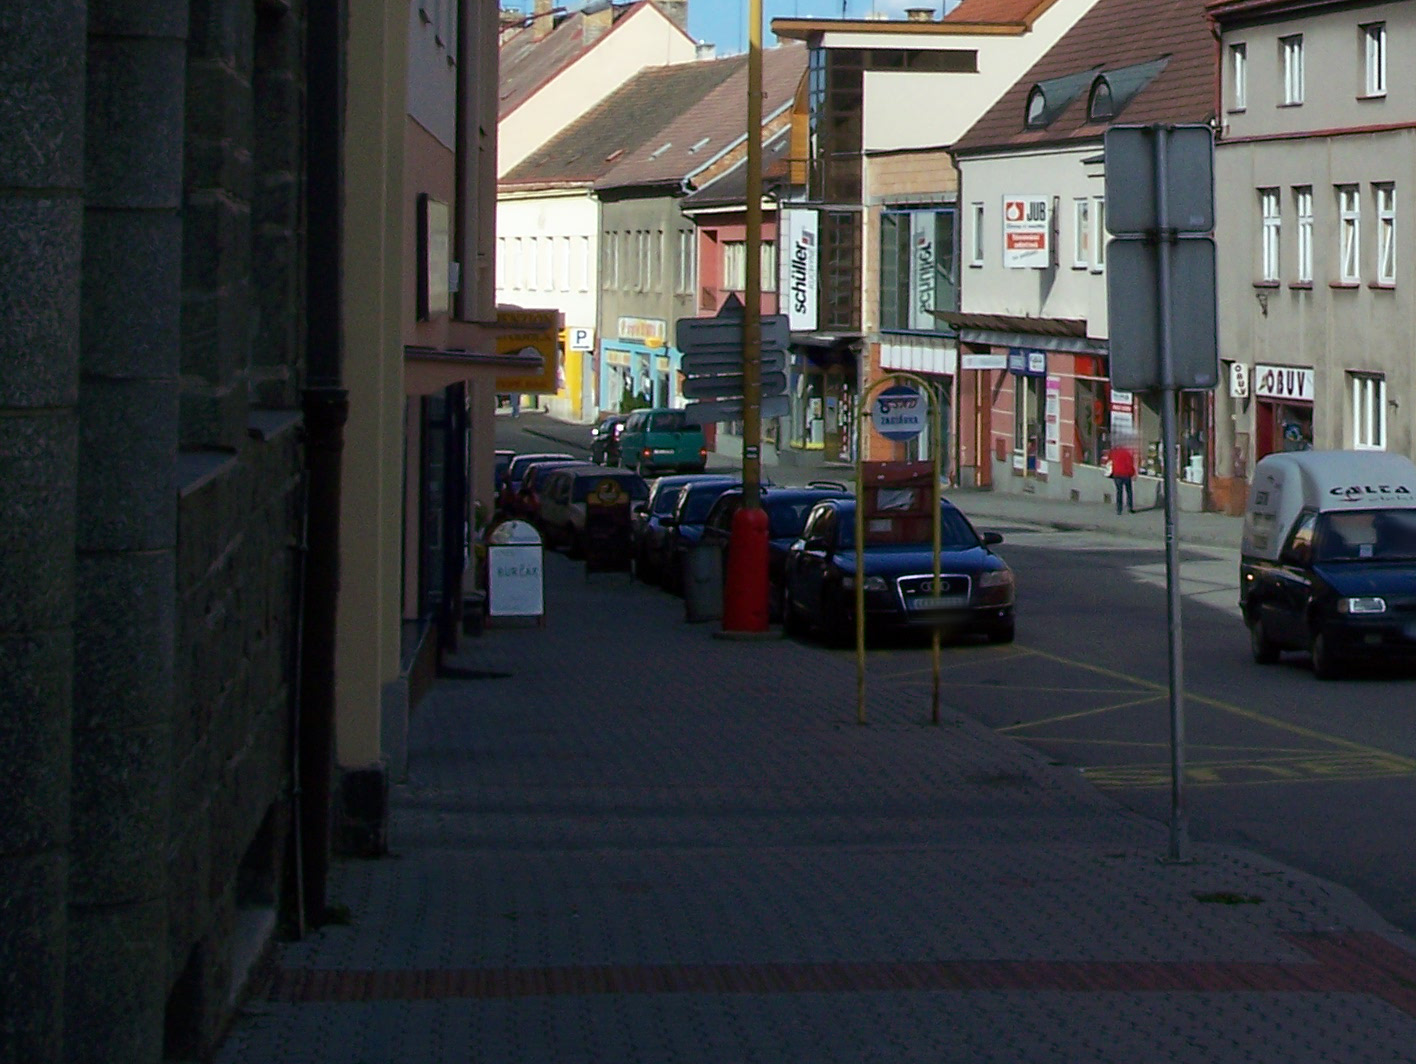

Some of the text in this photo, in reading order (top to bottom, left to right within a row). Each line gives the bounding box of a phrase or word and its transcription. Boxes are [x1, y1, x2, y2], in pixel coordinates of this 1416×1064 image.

[1027, 202, 1046, 221] JUB
[791, 241, 808, 314] schüller
[576, 330, 587, 344] P
[1234, 365, 1247, 395] OBUV
[1267, 369, 1306, 396] OBUV
